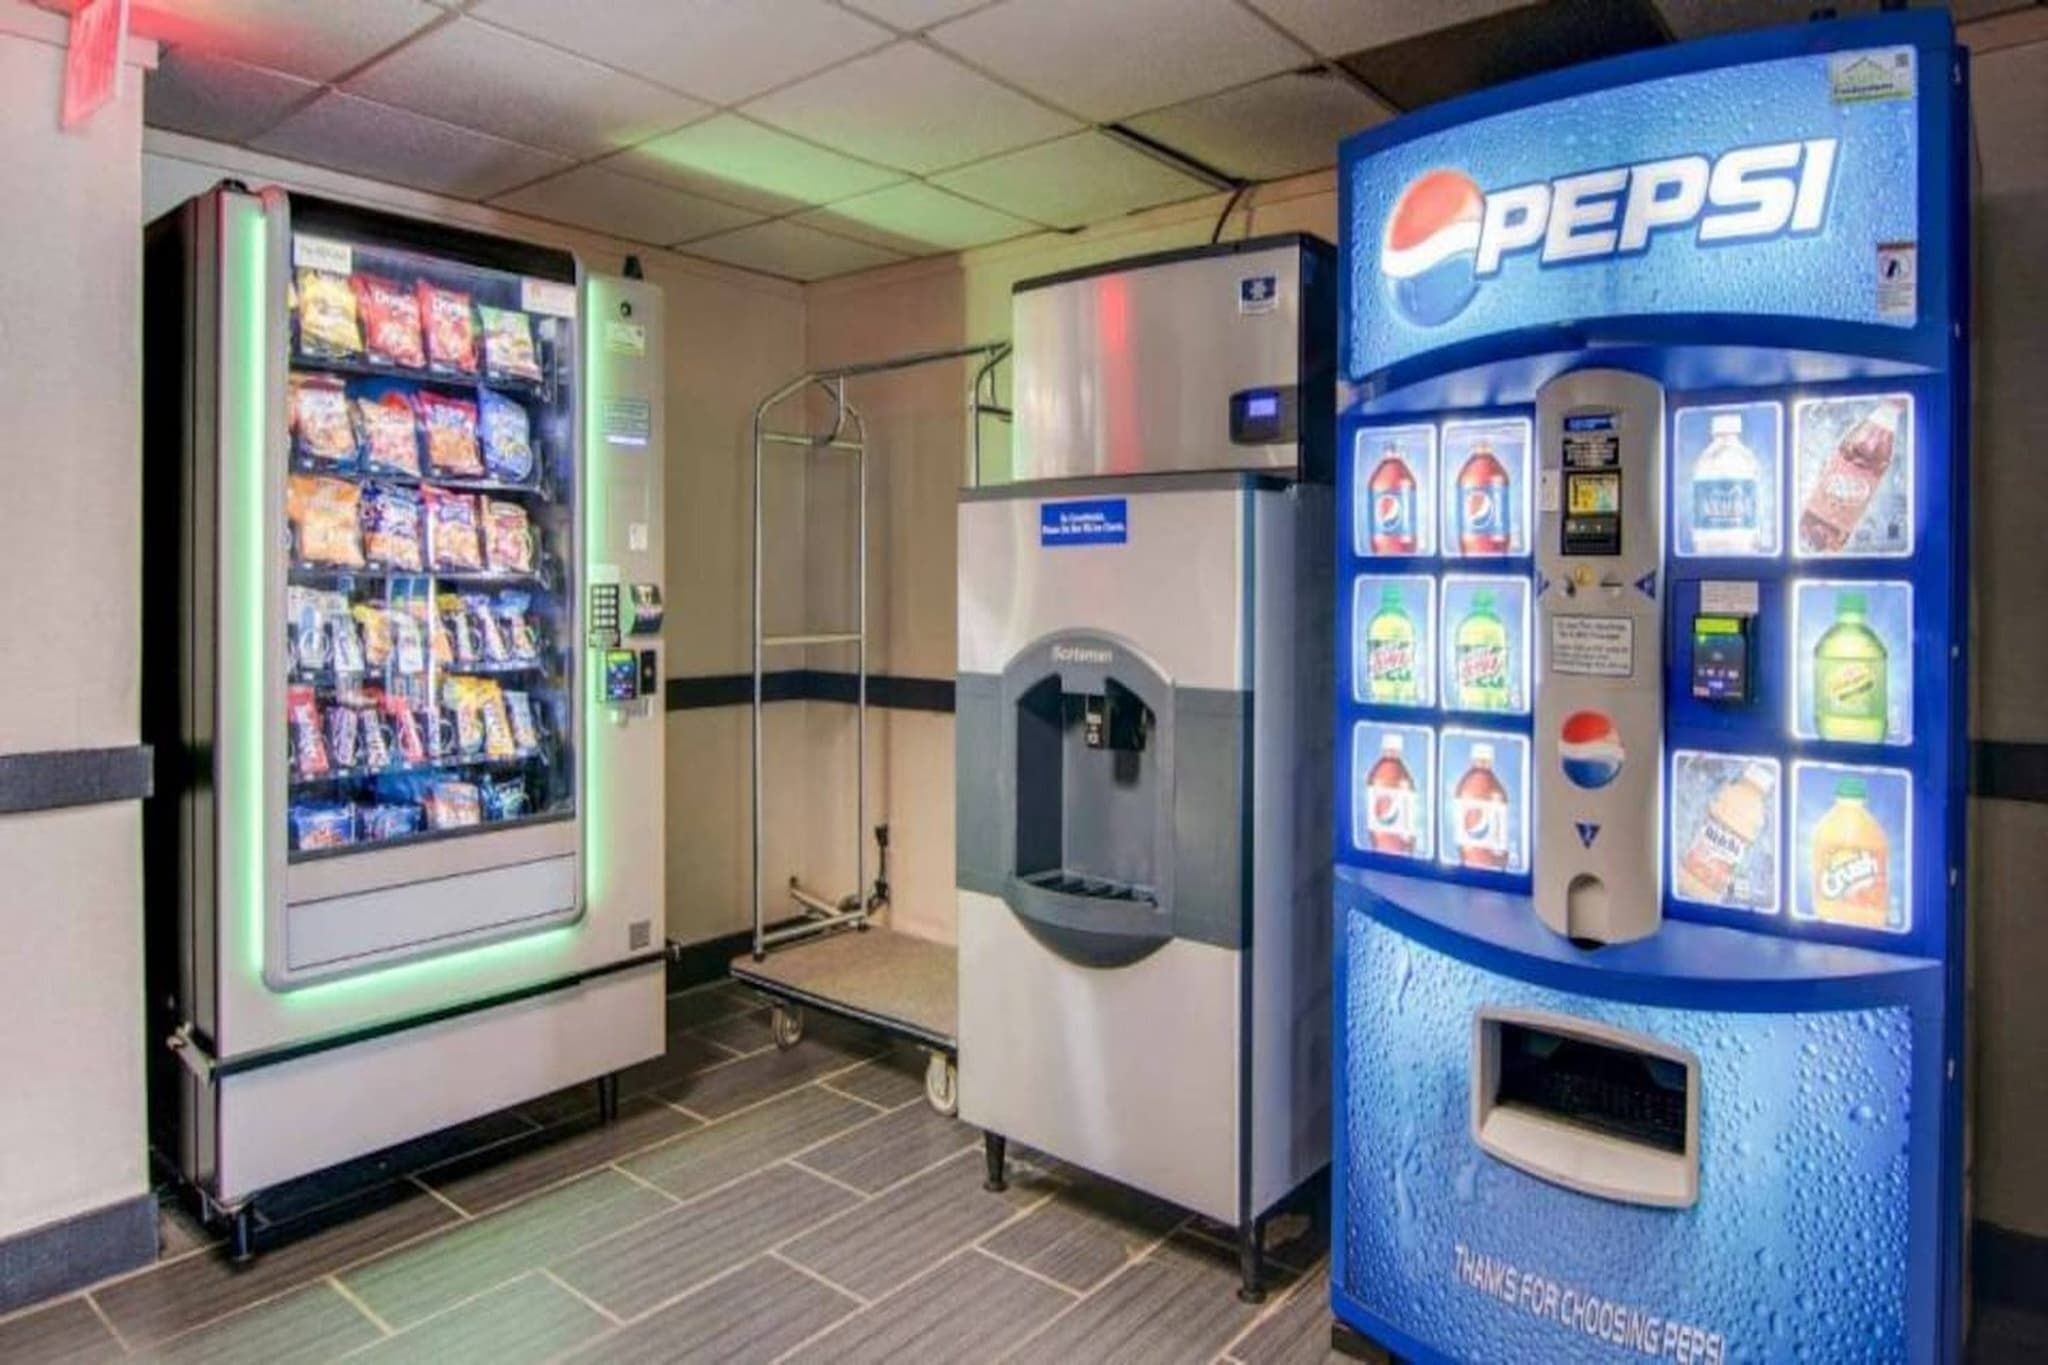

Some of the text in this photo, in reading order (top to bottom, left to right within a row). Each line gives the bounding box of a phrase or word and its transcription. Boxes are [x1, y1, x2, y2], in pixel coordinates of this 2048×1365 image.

[1473, 138, 1841, 276] PEPSI
[1455, 1244, 1726, 1365] THANKS FOR CHOOSING PEPSI
